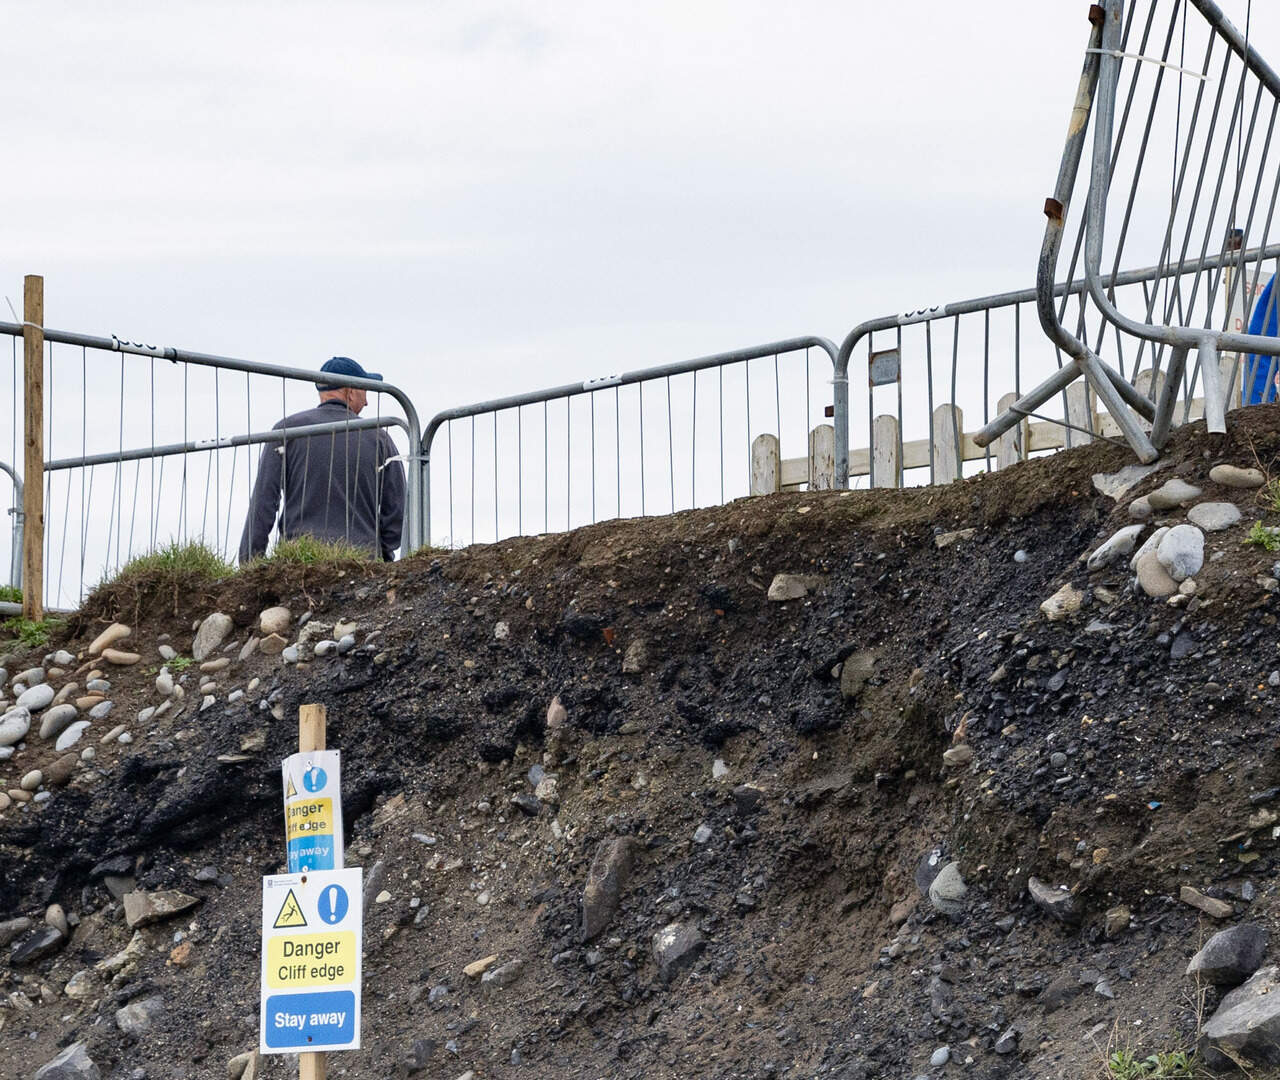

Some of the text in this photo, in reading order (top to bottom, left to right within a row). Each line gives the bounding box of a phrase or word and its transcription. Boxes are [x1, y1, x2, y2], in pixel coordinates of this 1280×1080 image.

[283, 941, 340, 959] Danger
[278, 963, 344, 981] Cliff edge
[274, 1011, 346, 1030] Stay away
